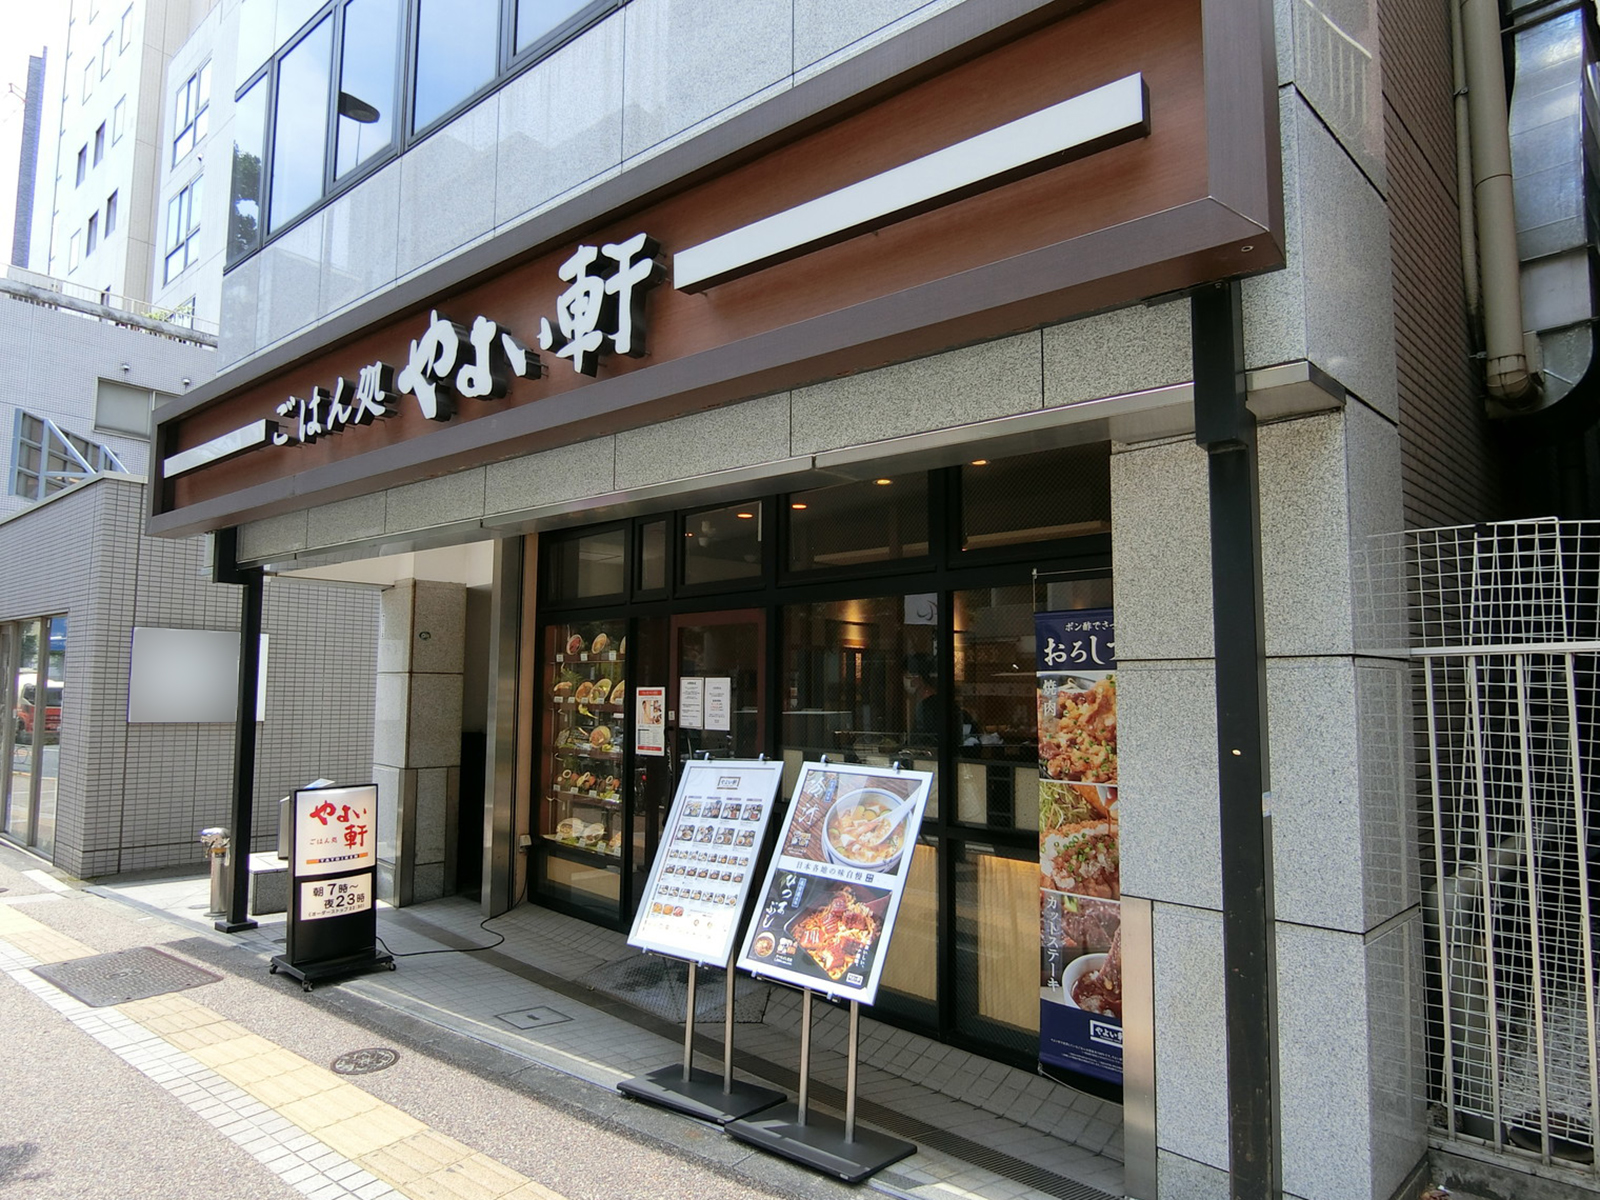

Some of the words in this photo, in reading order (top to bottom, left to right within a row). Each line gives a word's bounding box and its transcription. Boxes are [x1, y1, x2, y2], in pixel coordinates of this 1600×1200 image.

[273, 361, 386, 446] ごはん処
[398, 232, 653, 420] やよい軒
[1043, 679, 1058, 716] 焼肉
[310, 801, 367, 825] やよい
[309, 836, 338, 846] ごはん処
[344, 824, 368, 849] 軒
[324, 893, 365, 909] 夜23時
[1047, 896, 1060, 992] カットステーキ
